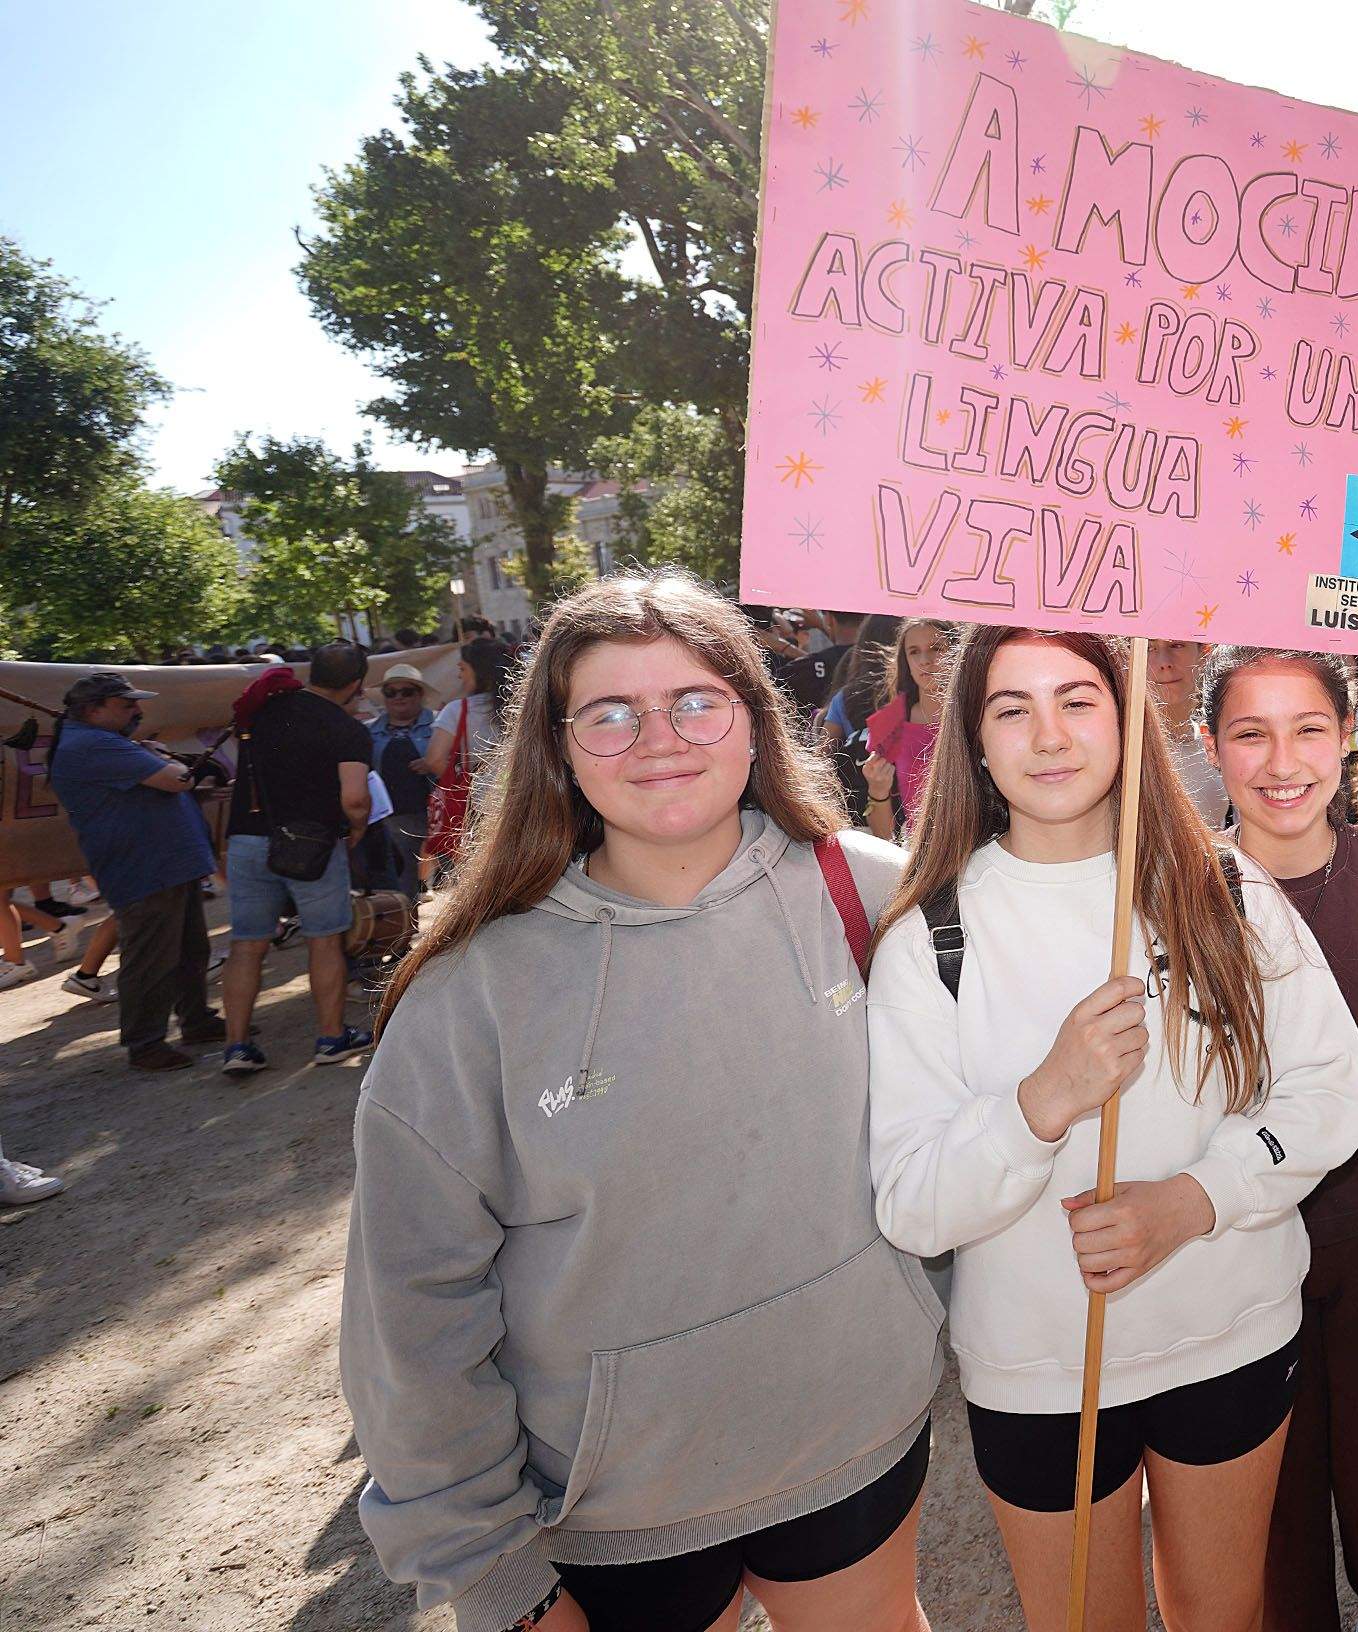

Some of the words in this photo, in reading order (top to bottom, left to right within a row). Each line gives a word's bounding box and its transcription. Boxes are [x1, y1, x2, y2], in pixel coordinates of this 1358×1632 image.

[931, 72, 1019, 236] A
[790, 232, 1108, 380] ACTIVA
[1137, 302, 1260, 405] POR
[902, 373, 1201, 519] LINGUA
[877, 485, 1138, 613] VIVA
